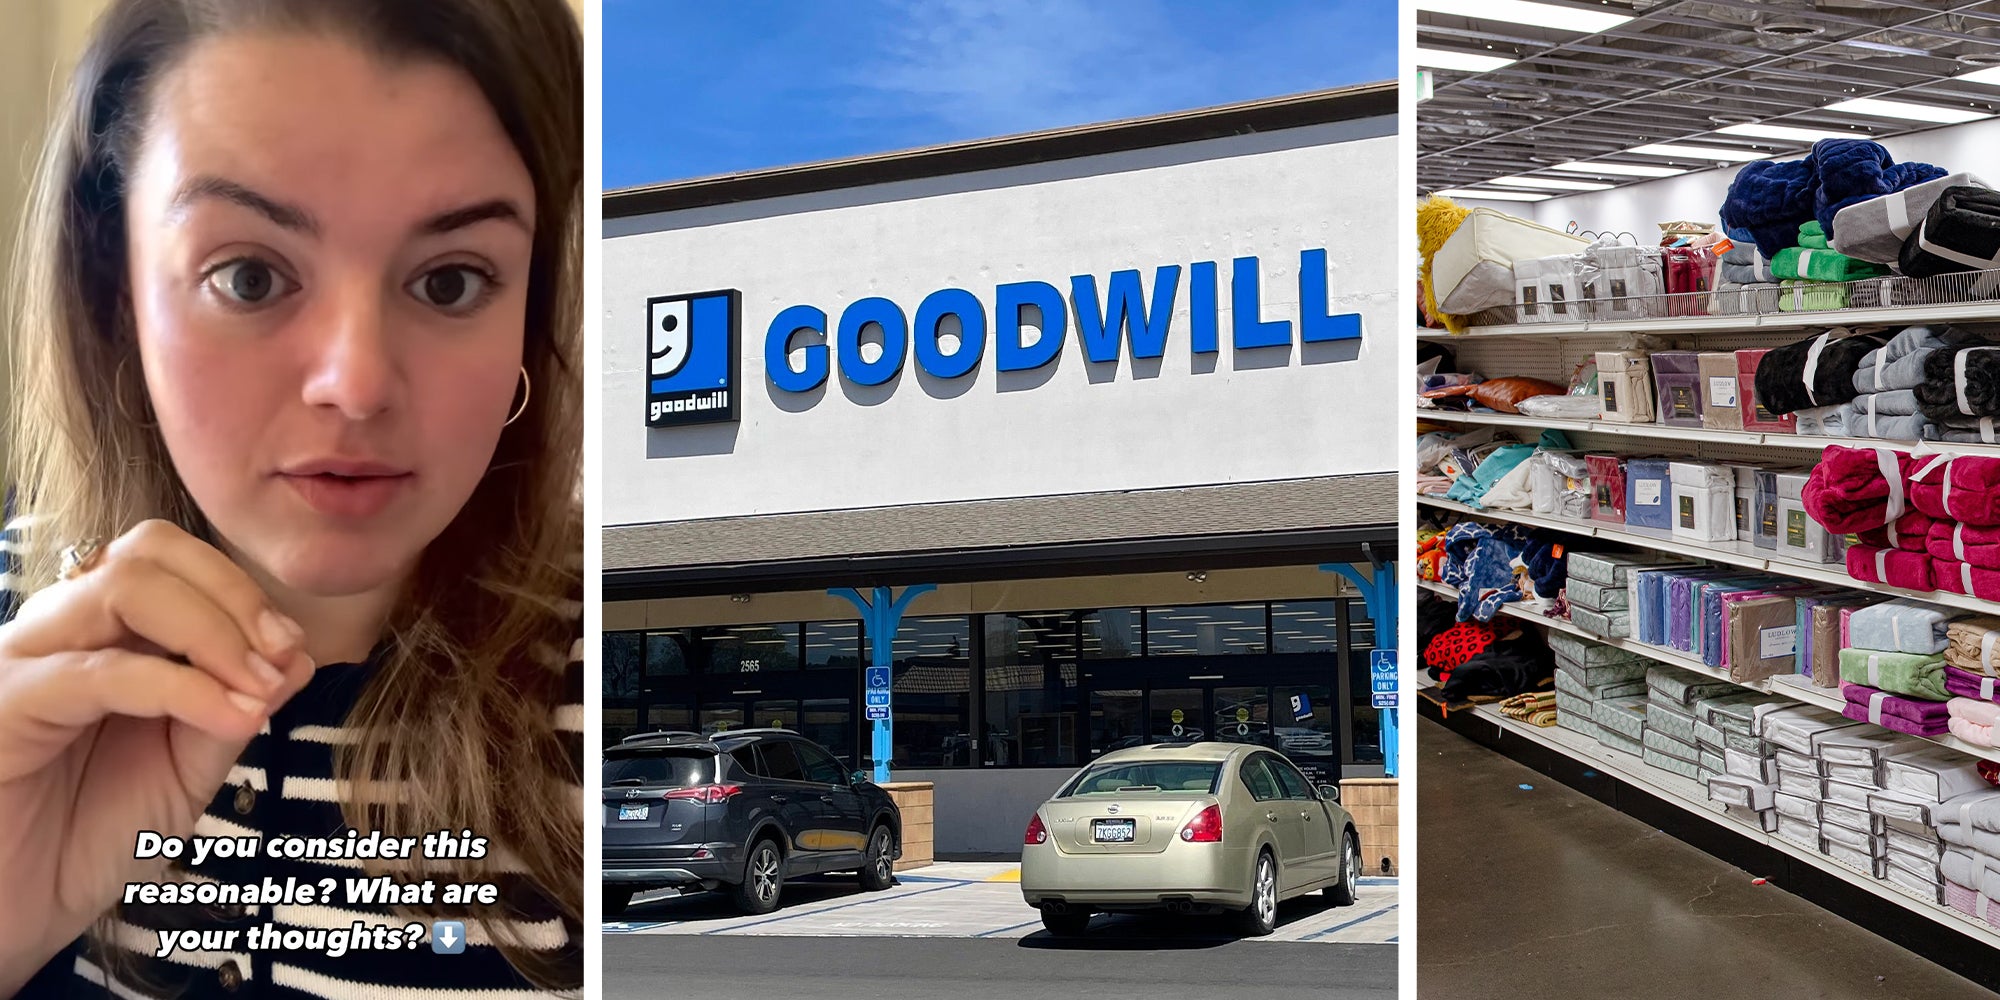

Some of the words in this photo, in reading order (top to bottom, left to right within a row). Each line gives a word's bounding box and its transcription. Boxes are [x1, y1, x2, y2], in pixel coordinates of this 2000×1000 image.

[764, 247, 1361, 393] GOODWILL
[650, 390, 728, 422] goodwill
[740, 660, 760, 673] 2565
[1373, 671, 1398, 681] PARKING
[1377, 681, 1394, 691] ONLY
[870, 695, 886, 704] ONLY
